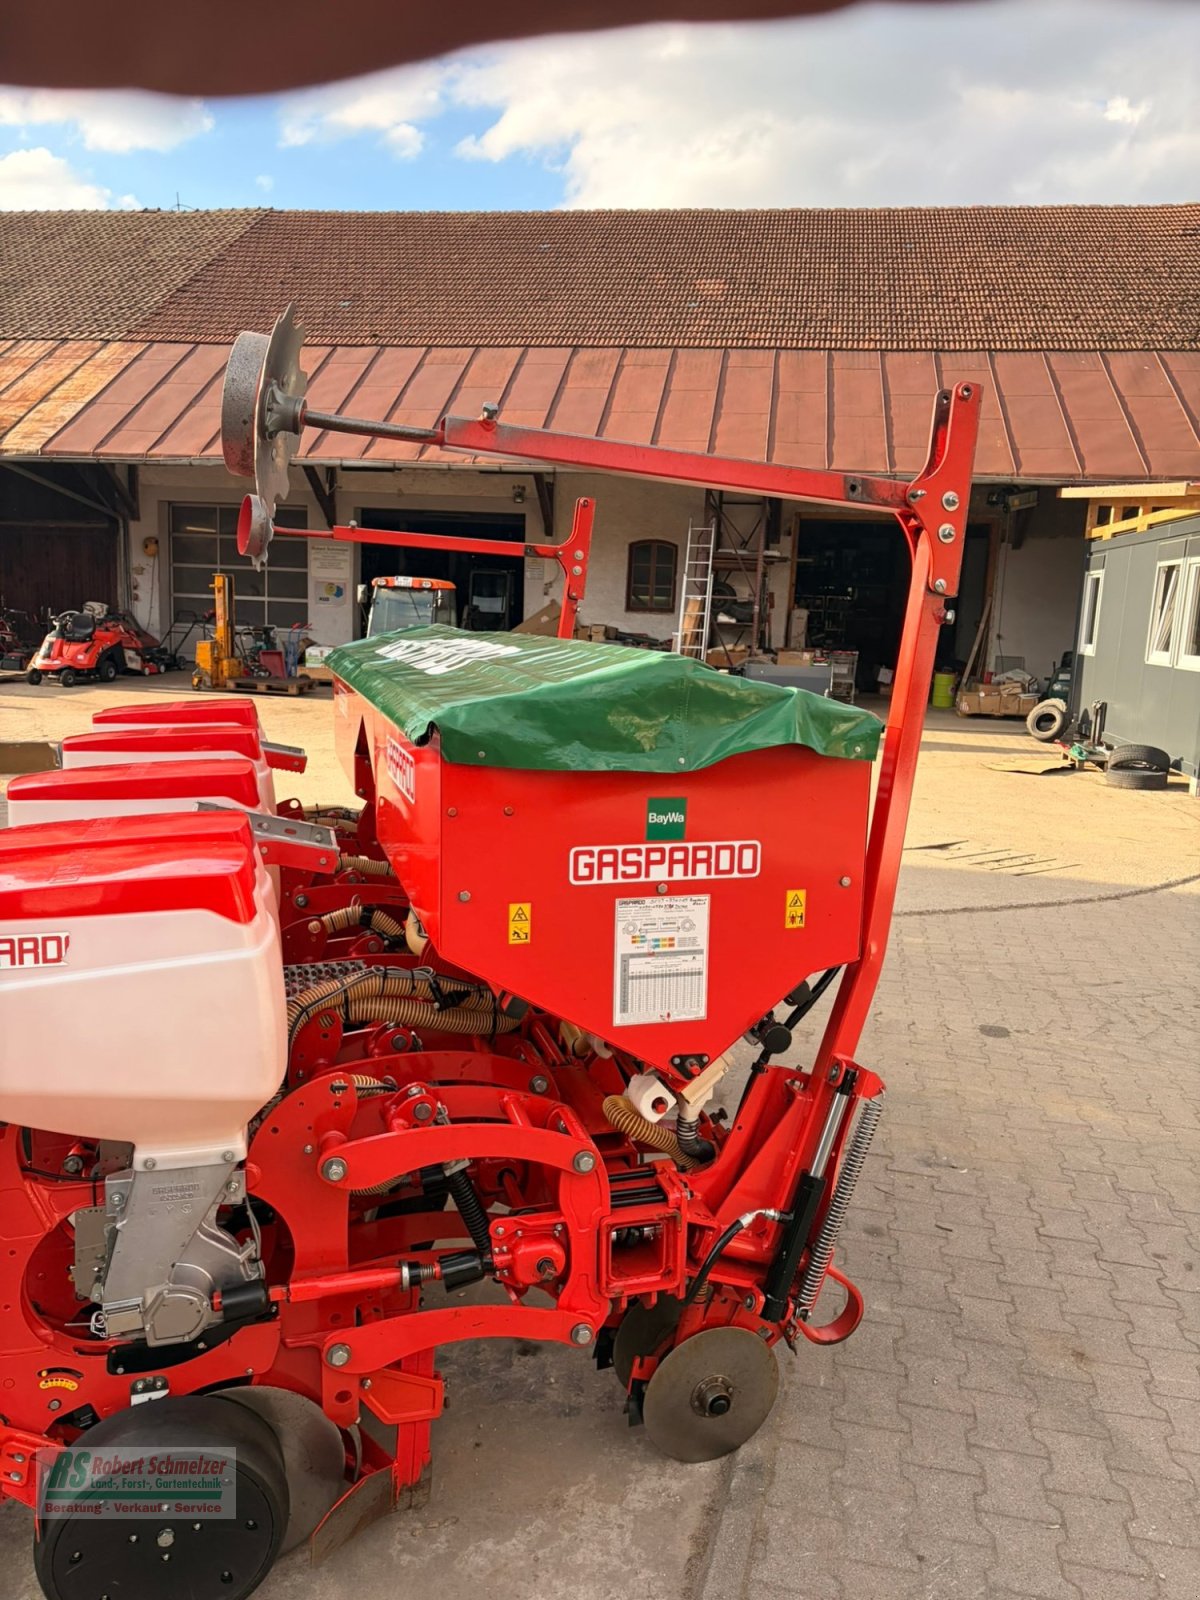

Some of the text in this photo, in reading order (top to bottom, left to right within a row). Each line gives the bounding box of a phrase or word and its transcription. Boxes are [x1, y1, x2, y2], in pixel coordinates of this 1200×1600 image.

[648, 812, 685, 825] BayWa
[573, 843, 758, 882] GASPARDO
[0, 935, 70, 965] ARD
